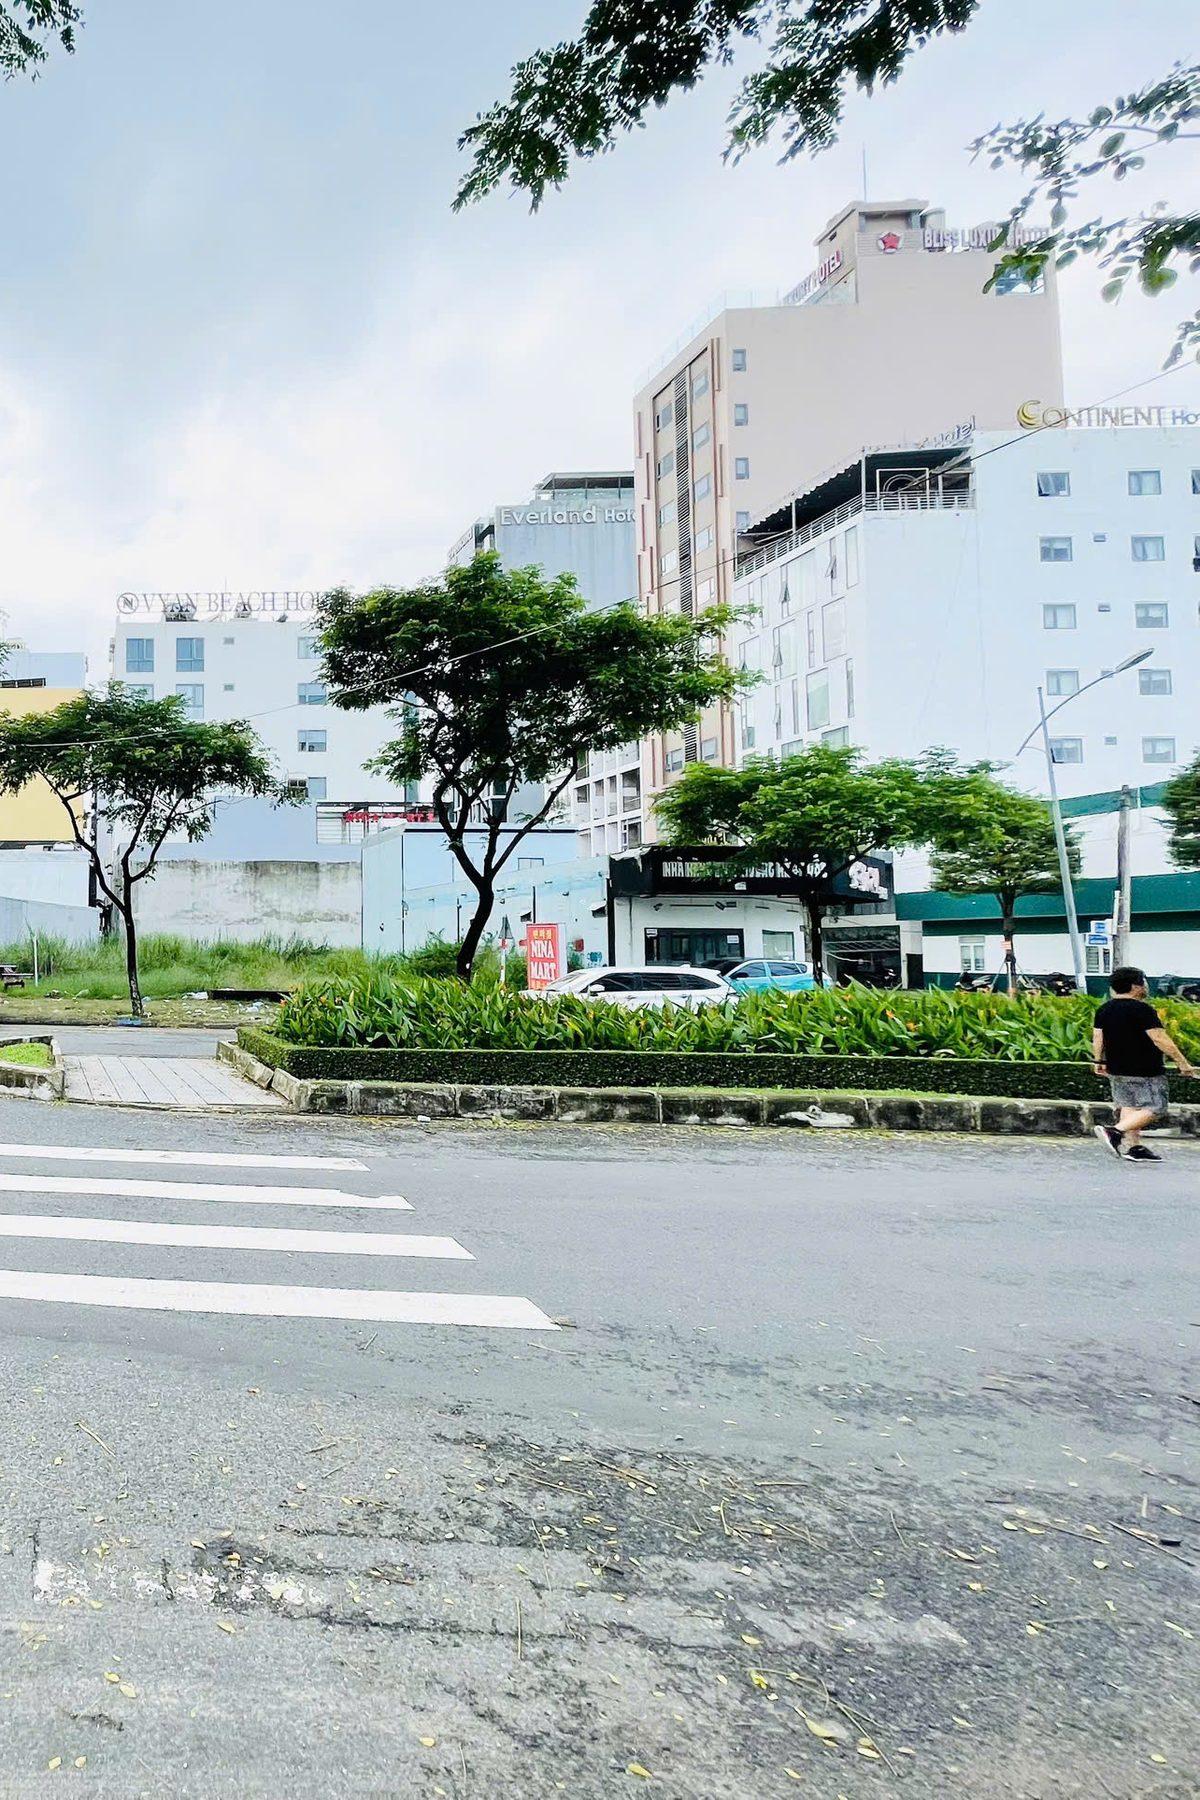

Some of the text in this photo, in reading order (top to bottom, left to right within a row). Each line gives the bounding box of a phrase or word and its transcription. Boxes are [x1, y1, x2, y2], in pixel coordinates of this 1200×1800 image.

[923, 228, 960, 248] BLISS
[1017, 400, 1200, 429] CONTINENT HO
[501, 505, 597, 525] Everland
[207, 592, 276, 613] BEACH
[530, 940, 555, 959] NINA
[530, 962, 557, 981] MART
